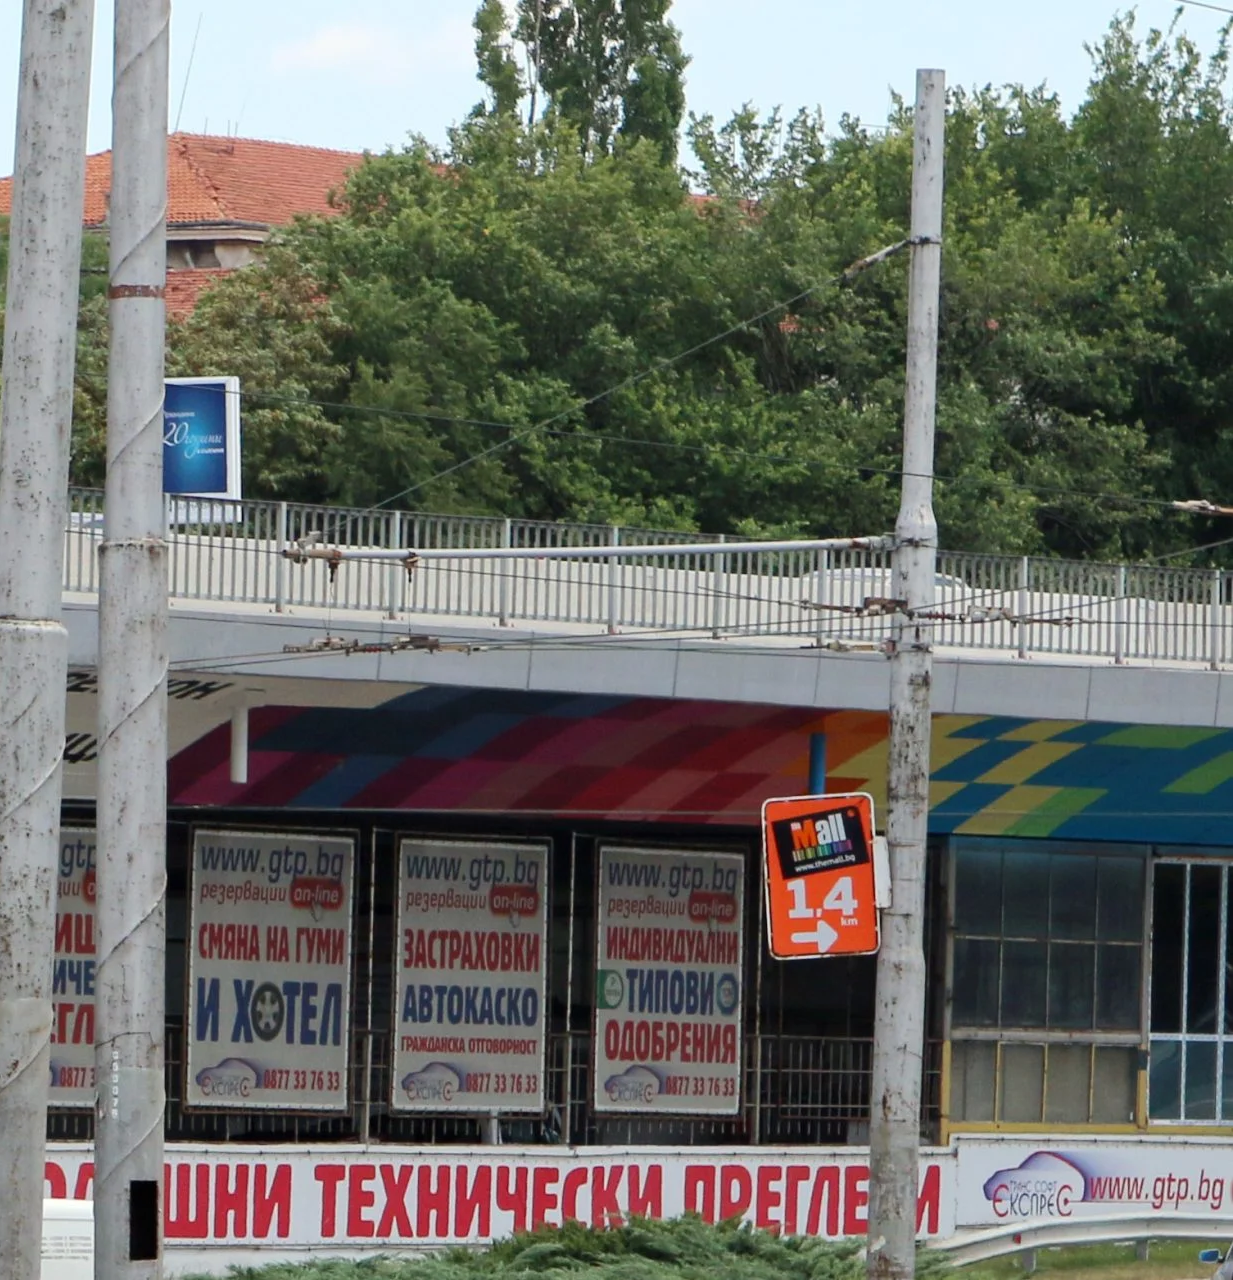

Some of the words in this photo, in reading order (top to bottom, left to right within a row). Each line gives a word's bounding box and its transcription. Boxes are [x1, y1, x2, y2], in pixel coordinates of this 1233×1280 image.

[791, 813, 846, 850] Mall
[201, 844, 344, 883] www.gtp.bg
[406, 853, 540, 892] www.gtp.bg
[608, 861, 737, 896] www.gtp.bg
[794, 854, 856, 872] www.themall.bg
[199, 881, 287, 905] резервации
[294, 885, 339, 904] on-line
[405, 889, 486, 912] резервации
[493, 893, 535, 911] on-line
[607, 896, 685, 918] резервации
[692, 899, 733, 917] on-line
[841, 916, 858, 926] km
[198, 922, 260, 962] СМЯНА
[267, 925, 290, 963] НА
[296, 927, 344, 965] ГУМИ
[403, 928, 540, 972] ЗАСТРАХОВКИ
[606, 926, 738, 965] ИНДИВИДУАЛНИ
[196, 976, 220, 1042] И
[402, 984, 538, 1026] АВТОКАСКО
[626, 968, 715, 1016] ТИПОВИ
[400, 1035, 465, 1054] ГРАЖДАНСКА
[468, 1036, 537, 1055] ОТГОВОРНОСТ
[604, 1019, 736, 1064] ОДОБРЕНИЯ
[59, 1067, 86, 1088] 0877
[264, 1068, 290, 1090] 0877
[294, 1069, 307, 1090] 33
[311, 1070, 324, 1090] 76
[327, 1071, 340, 1091] 33
[467, 1072, 491, 1092] 0877
[494, 1073, 507, 1093] 33
[511, 1073, 522, 1093] 76
[526, 1074, 538, 1093] 33
[666, 1075, 690, 1096] 0877
[692, 1076, 705, 1096] 33
[708, 1077, 719, 1096] 76
[722, 1077, 735, 1096] 33
[315, 1163, 664, 1238] ТЕХНИЧЕСКИ
[684, 1164, 941, 1236] ПРЕГЛЕИ
[1090, 1169, 1225, 1210] www.gtp.bg
